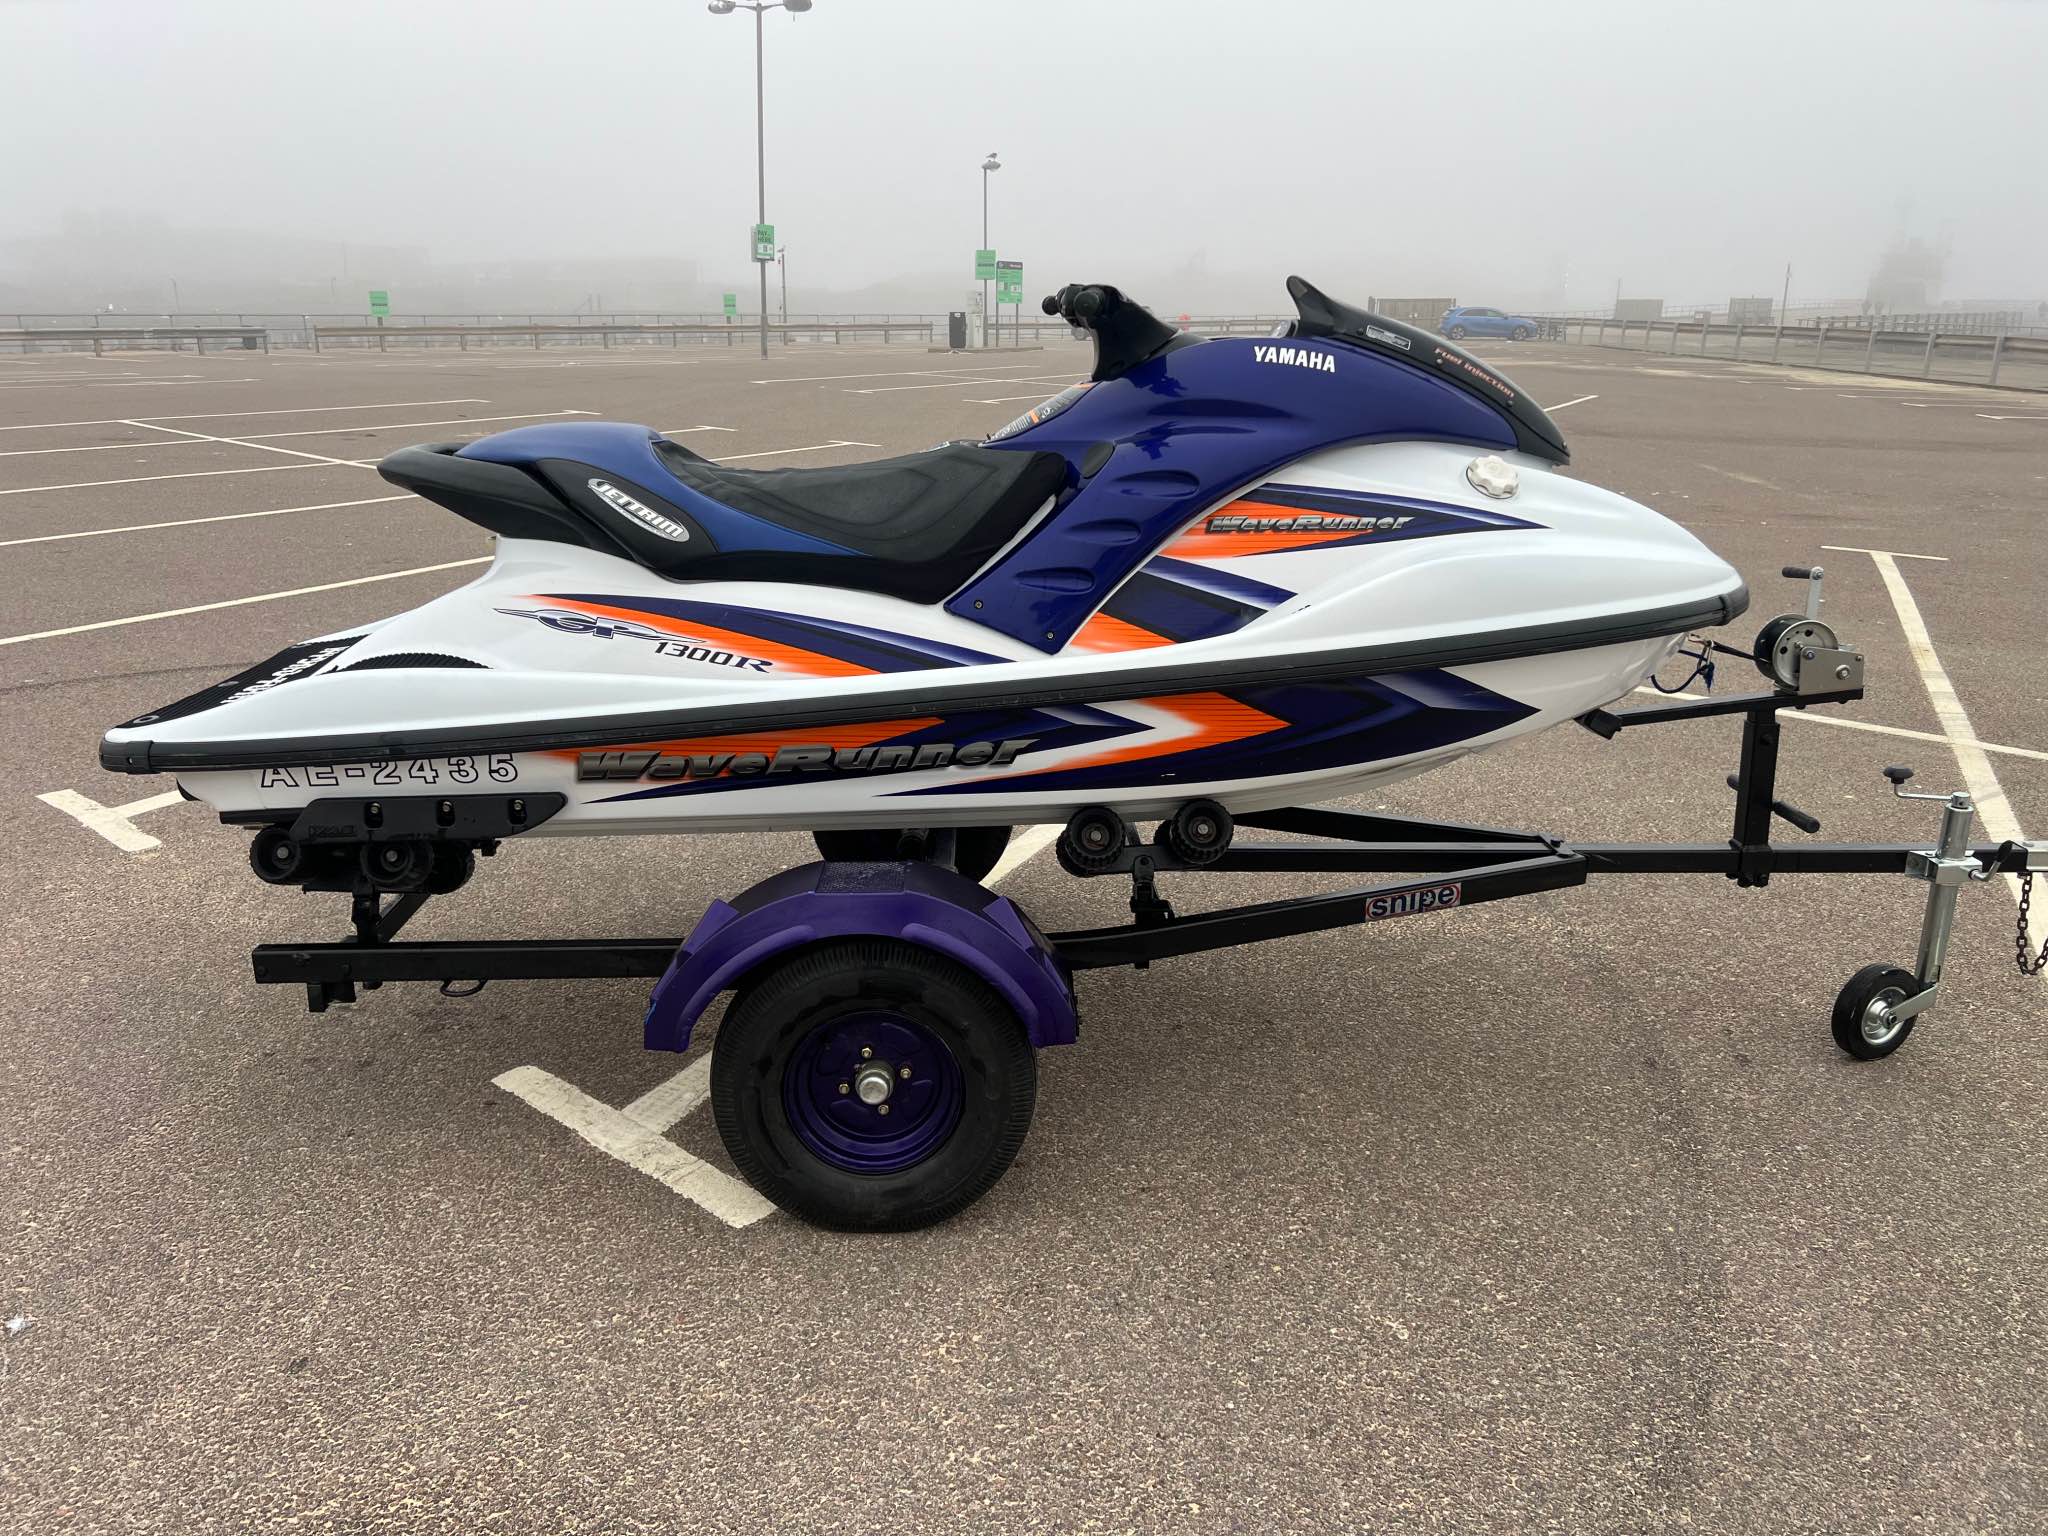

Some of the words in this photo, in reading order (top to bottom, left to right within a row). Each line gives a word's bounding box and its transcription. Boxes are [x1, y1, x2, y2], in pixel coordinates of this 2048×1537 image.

[1254, 346, 1335, 373] YAMAHA
[589, 482, 684, 538] JETTRIM
[1206, 515, 1415, 534] WaveRunner
[510, 608, 698, 639] GP
[654, 641, 773, 673] 1300R
[261, 753, 518, 788] AE-2435
[578, 739, 1040, 781] WaveRunner
[1371, 886, 1455, 916] snipe
